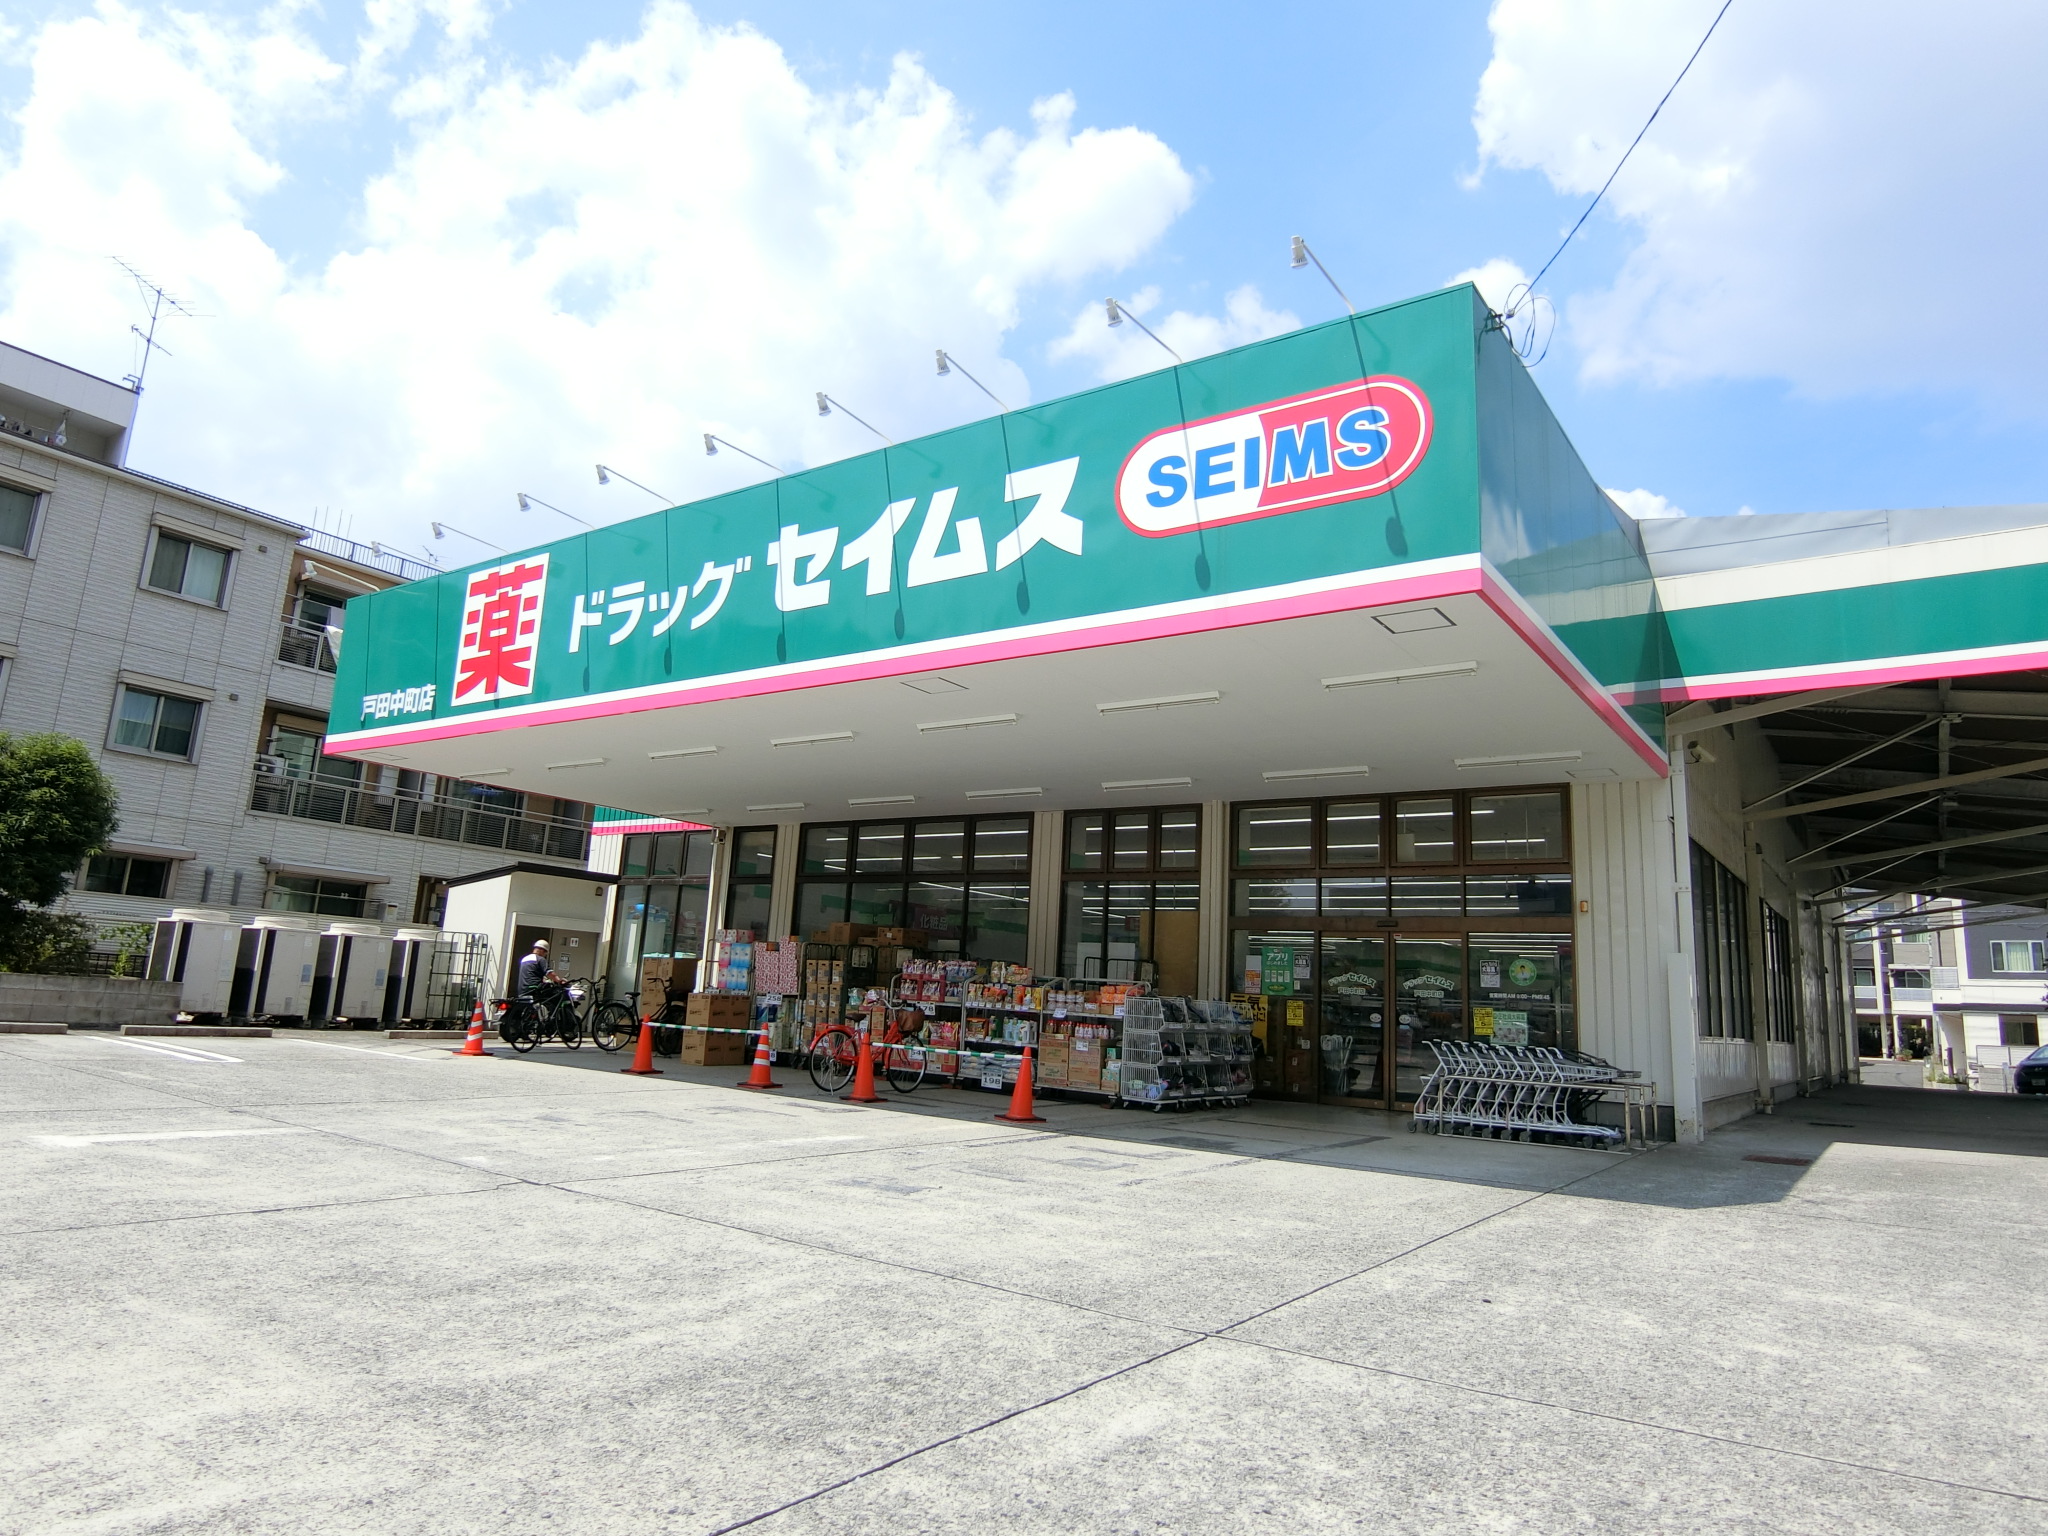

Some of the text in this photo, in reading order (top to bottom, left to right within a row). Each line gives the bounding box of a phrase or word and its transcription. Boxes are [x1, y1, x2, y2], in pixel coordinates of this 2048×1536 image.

[1146, 405, 1391, 508] SEIMS
[568, 456, 1084, 653] ドラッグ セイムス
[455, 563, 545, 700] 薬
[360, 683, 437, 722] 戸田中町店
[919, 913, 948, 931] 化粧品
[983, 1076, 1001, 1085] 198
